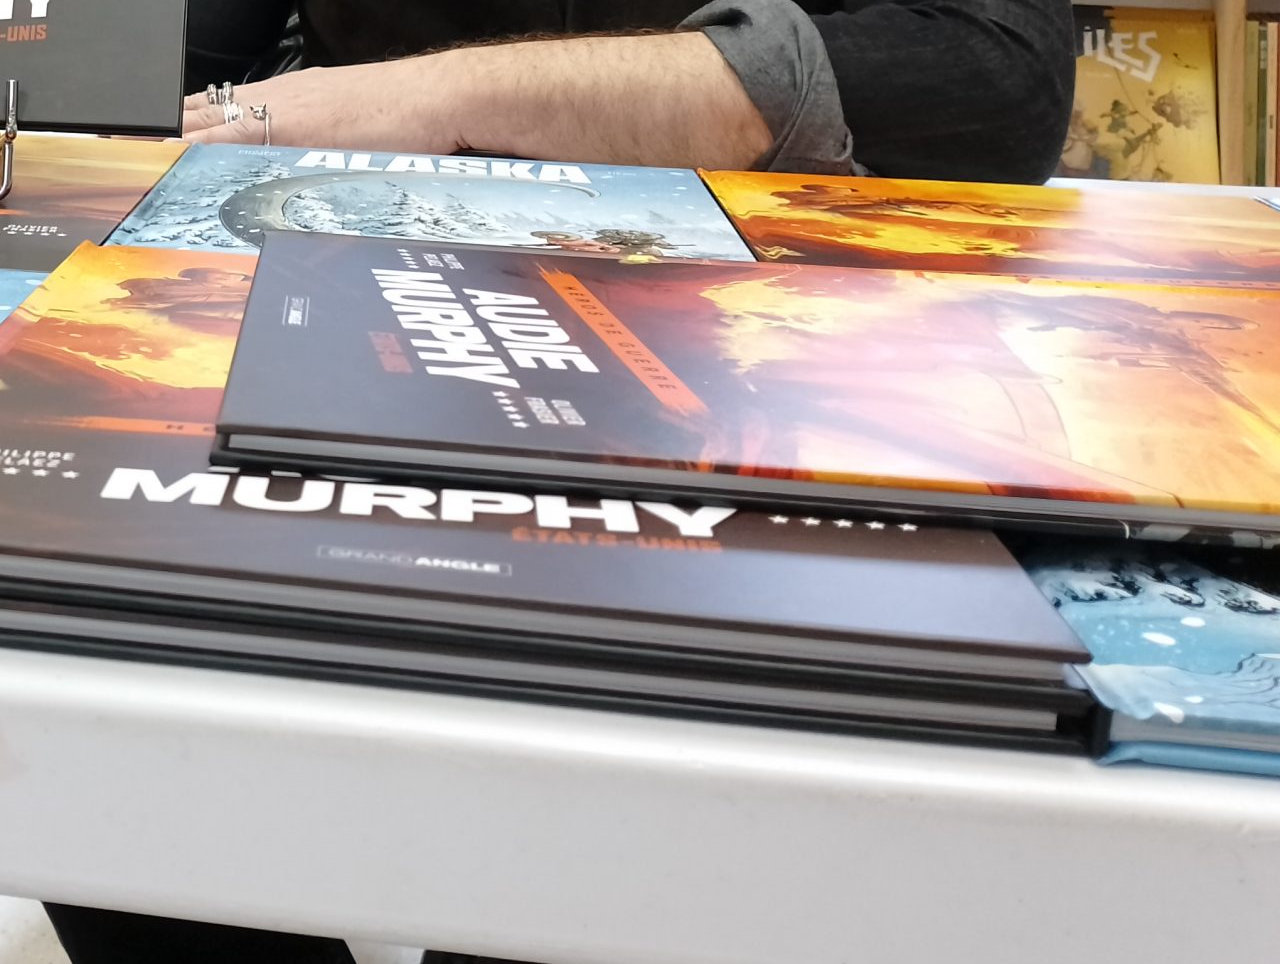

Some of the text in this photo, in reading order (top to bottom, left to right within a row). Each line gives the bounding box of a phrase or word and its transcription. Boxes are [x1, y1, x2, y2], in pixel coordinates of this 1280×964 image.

[294, 149, 592, 185] ALASKA
[371, 268, 521, 389] MURPHY
[463, 288, 600, 374] AUDIE
[100, 467, 738, 537] MURPHY
